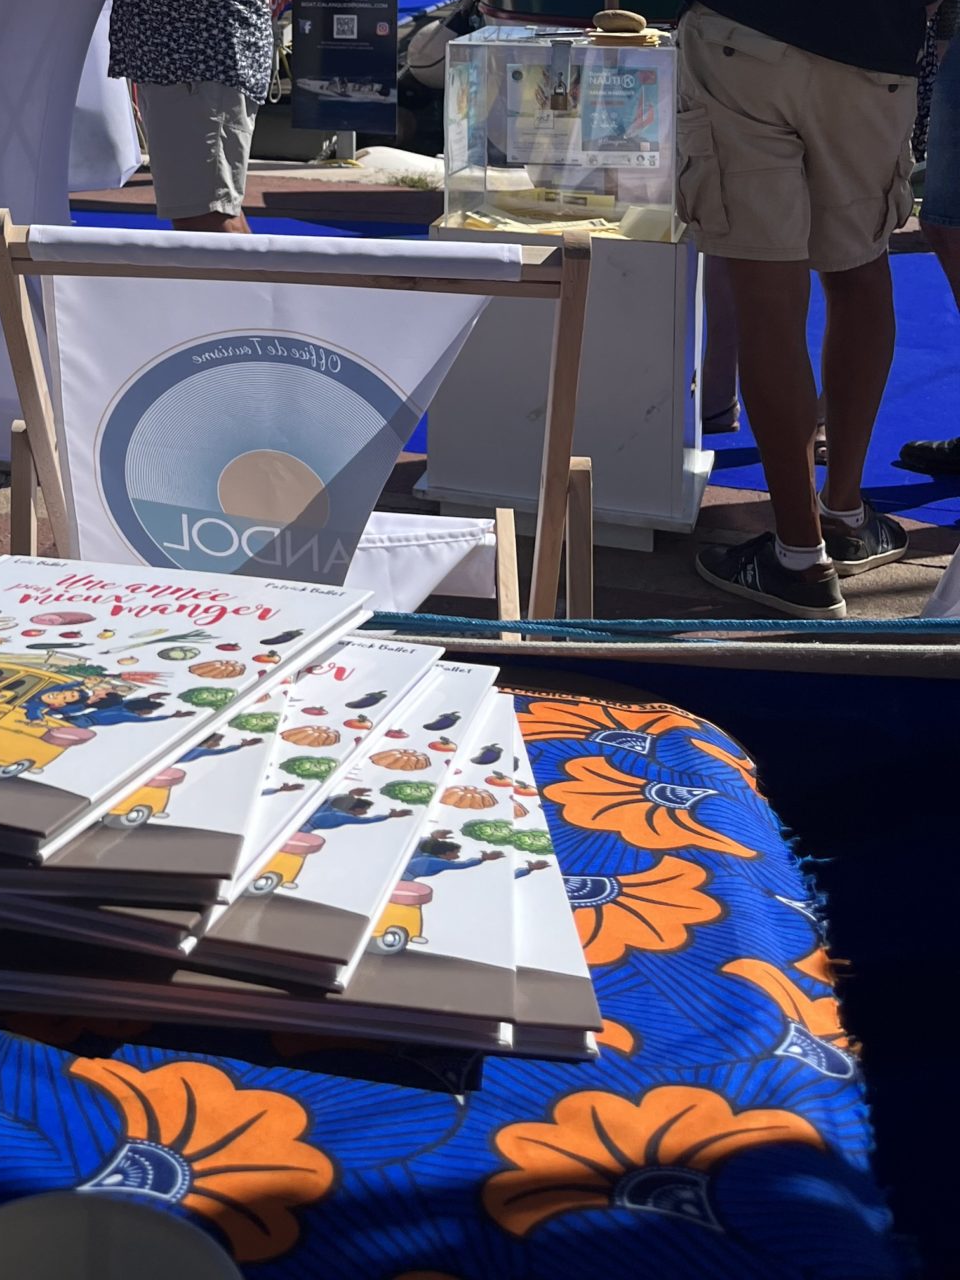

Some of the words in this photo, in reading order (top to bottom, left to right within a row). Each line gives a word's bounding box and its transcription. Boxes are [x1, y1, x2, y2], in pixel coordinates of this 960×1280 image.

[55, 573, 119, 590] Une
[125, 581, 240, 602] année
[110, 602, 281, 627] manger
